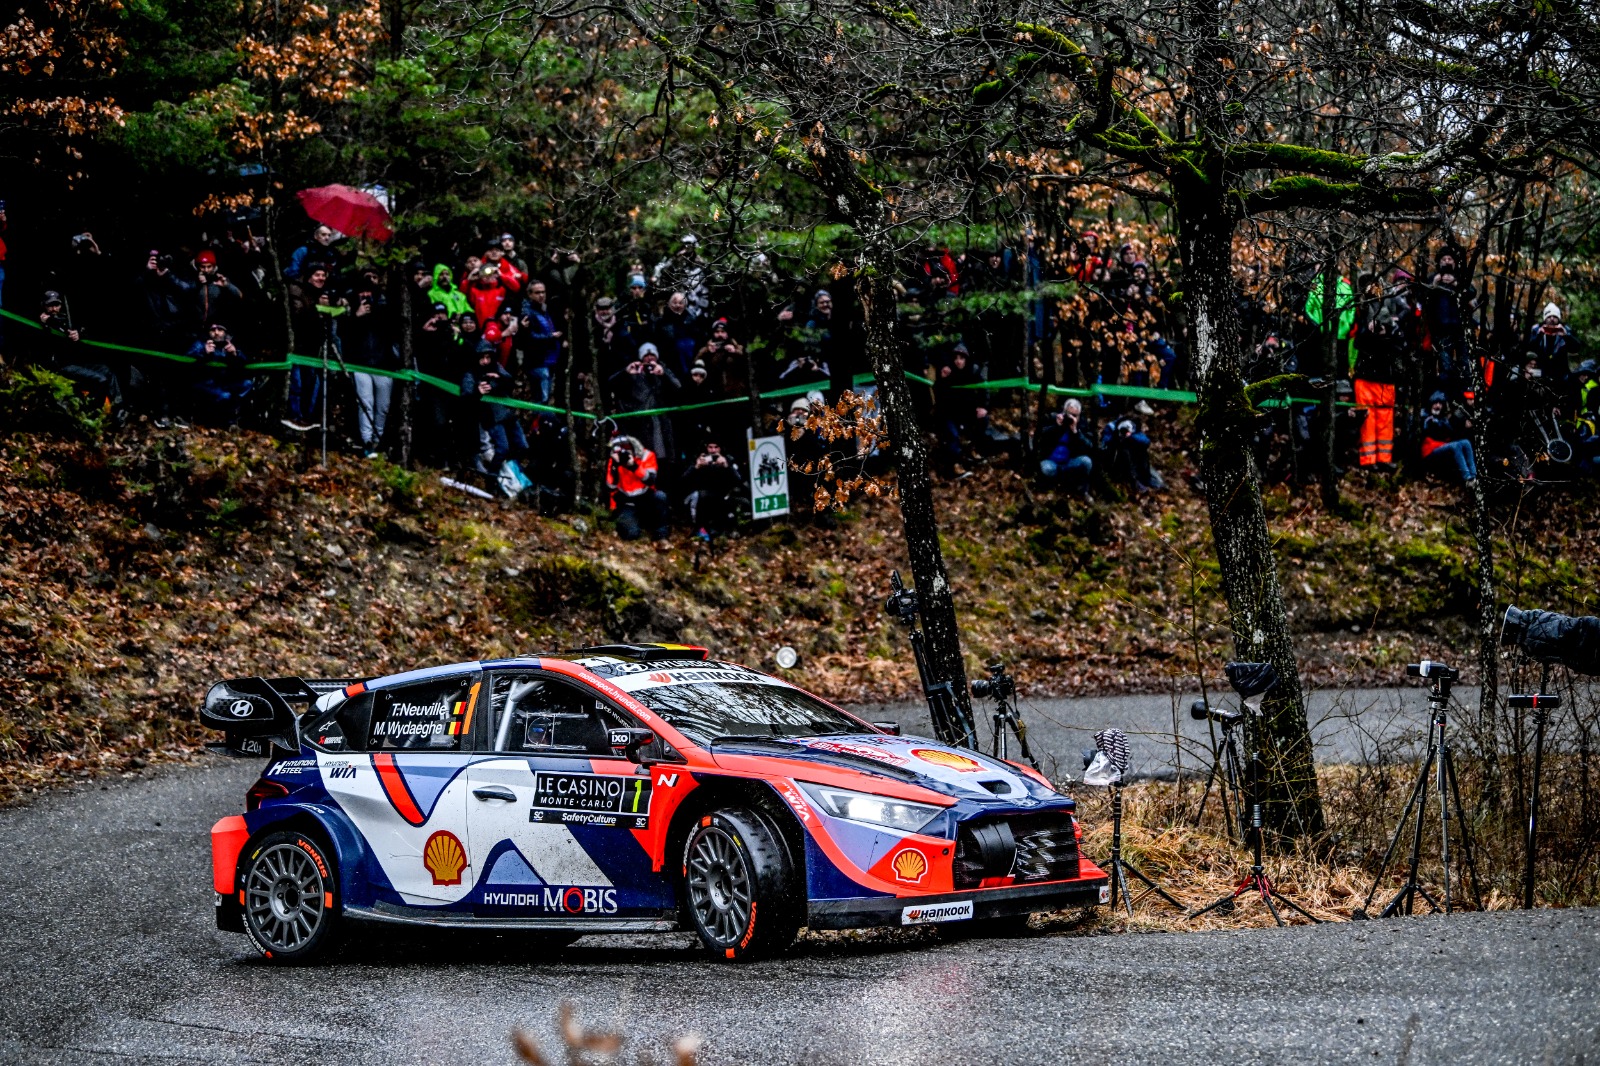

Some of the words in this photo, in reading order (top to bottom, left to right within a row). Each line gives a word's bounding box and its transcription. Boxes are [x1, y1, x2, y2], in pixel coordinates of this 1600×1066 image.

[462, 681, 482, 735] 1
[578, 672, 652, 721] motorsport.hyundai.com
[392, 702, 448, 717] T.Neuville
[538, 777, 555, 793] LE
[557, 778, 620, 797] CASINO
[631, 779, 643, 813] 1
[561, 812, 617, 825] SafetyCulture
[483, 892, 539, 906] HYUNDAI
[543, 887, 618, 914] MOBIS
